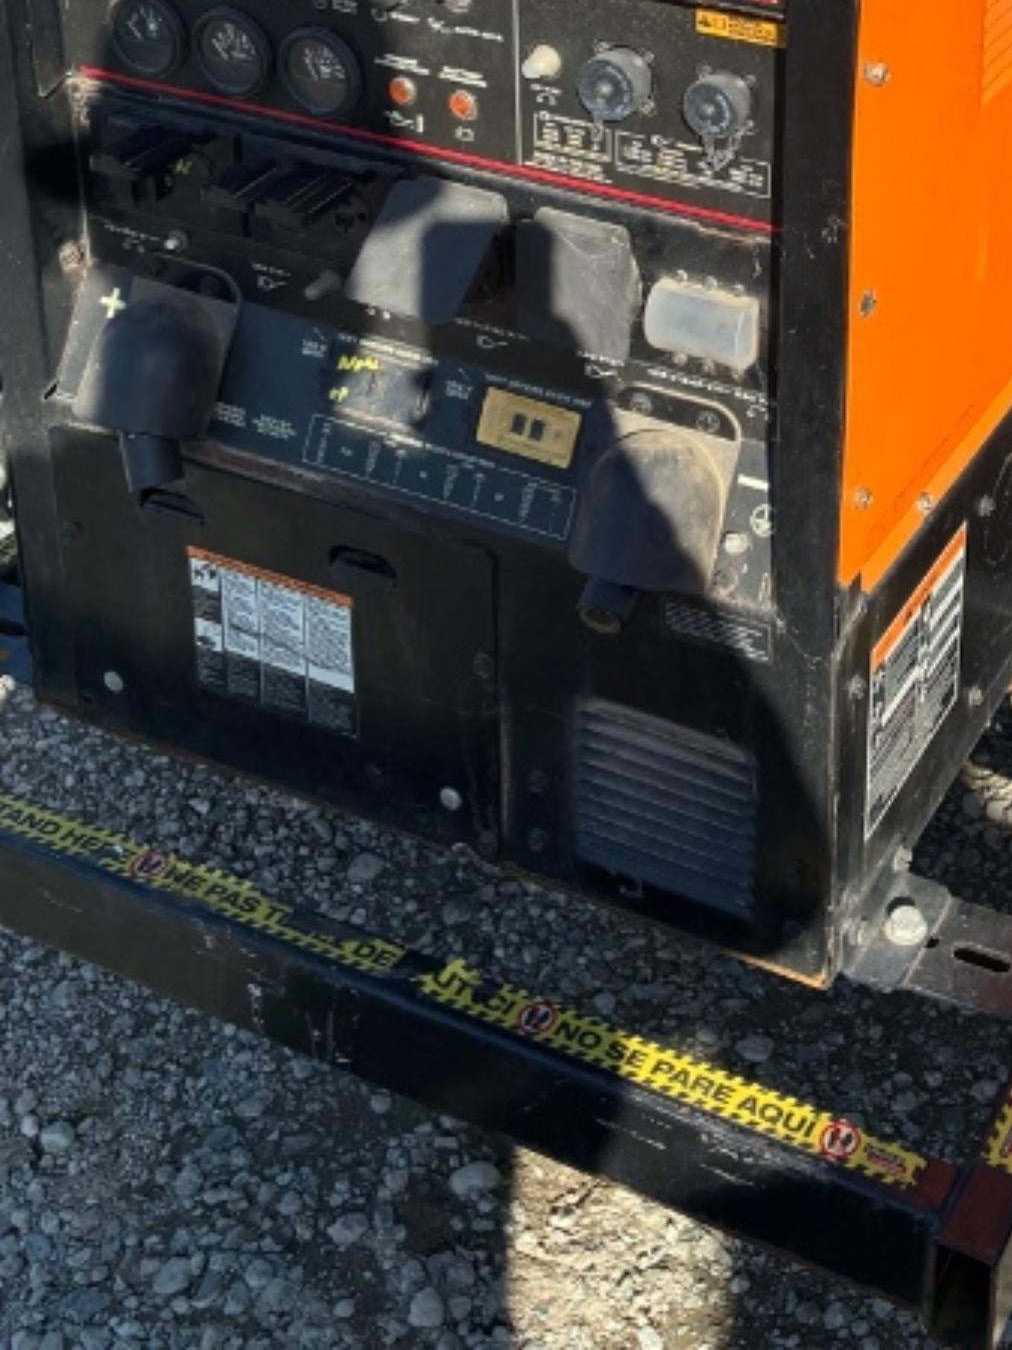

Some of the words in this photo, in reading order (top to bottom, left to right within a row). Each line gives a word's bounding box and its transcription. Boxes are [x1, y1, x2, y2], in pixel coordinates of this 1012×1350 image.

[204, 883, 261, 914] PAS
[555, 1021, 603, 1049] NO
[604, 1041, 650, 1069] SE
[650, 1058, 736, 1102] PARE
[736, 1095, 819, 1139] AQUI
